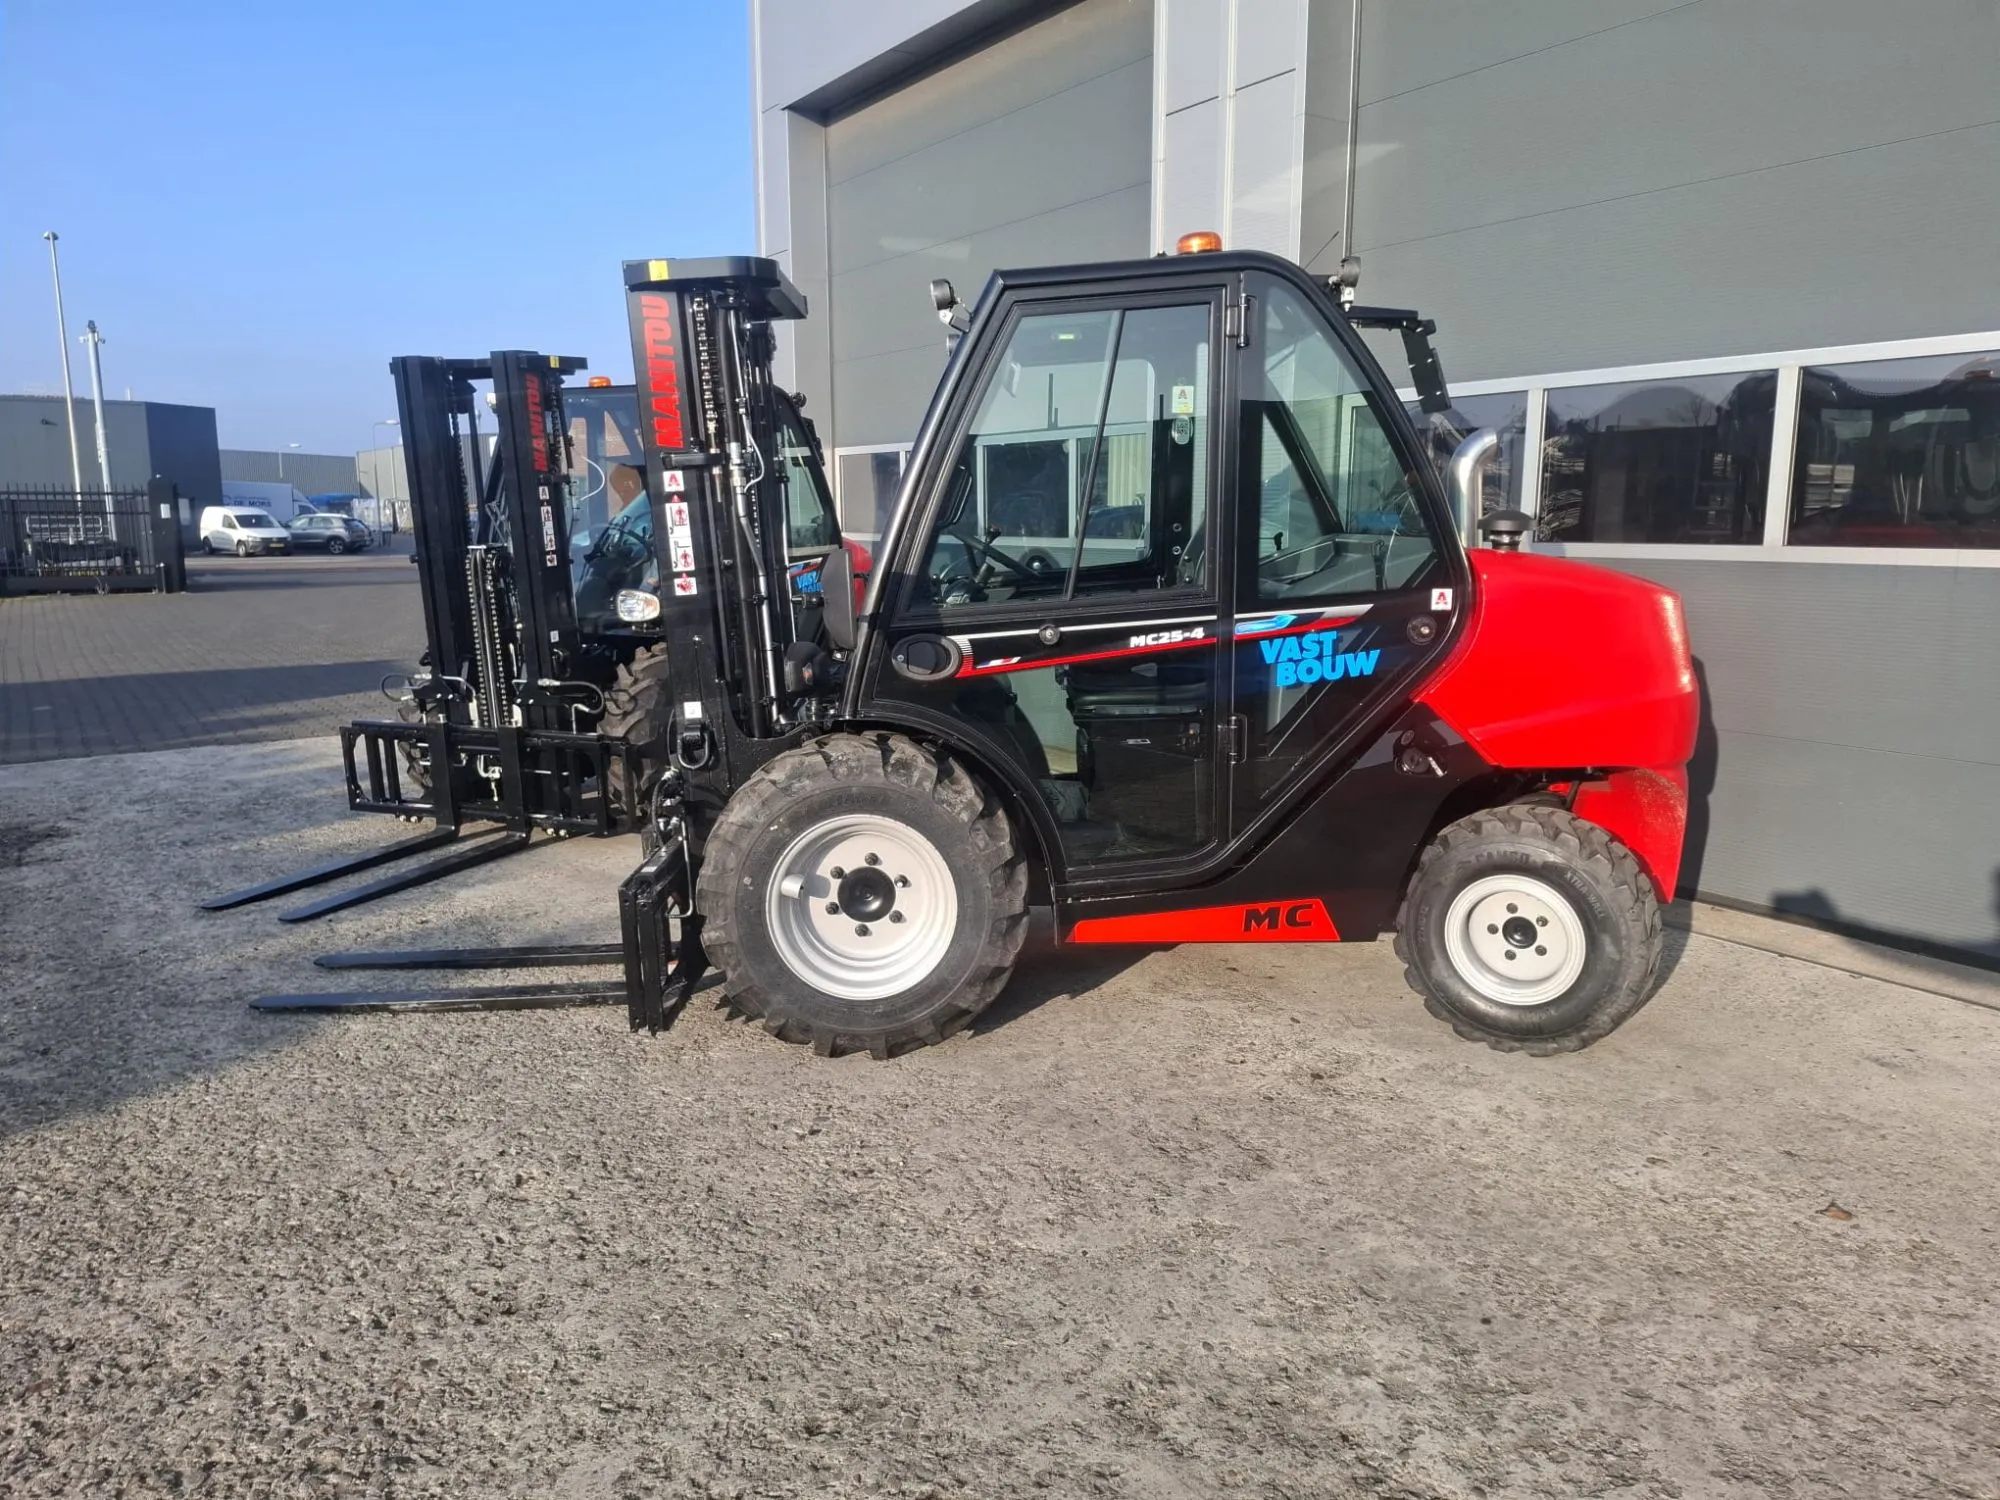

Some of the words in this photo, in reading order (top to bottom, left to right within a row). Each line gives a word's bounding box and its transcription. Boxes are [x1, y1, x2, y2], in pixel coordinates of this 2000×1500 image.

[640, 295, 684, 448] MANITOU
[525, 373, 549, 472] MANITOU
[1130, 627, 1204, 648] MC25-4
[1260, 631, 1337, 664] VAST
[1276, 649, 1382, 687] BOUW
[1243, 903, 1314, 932] MC
